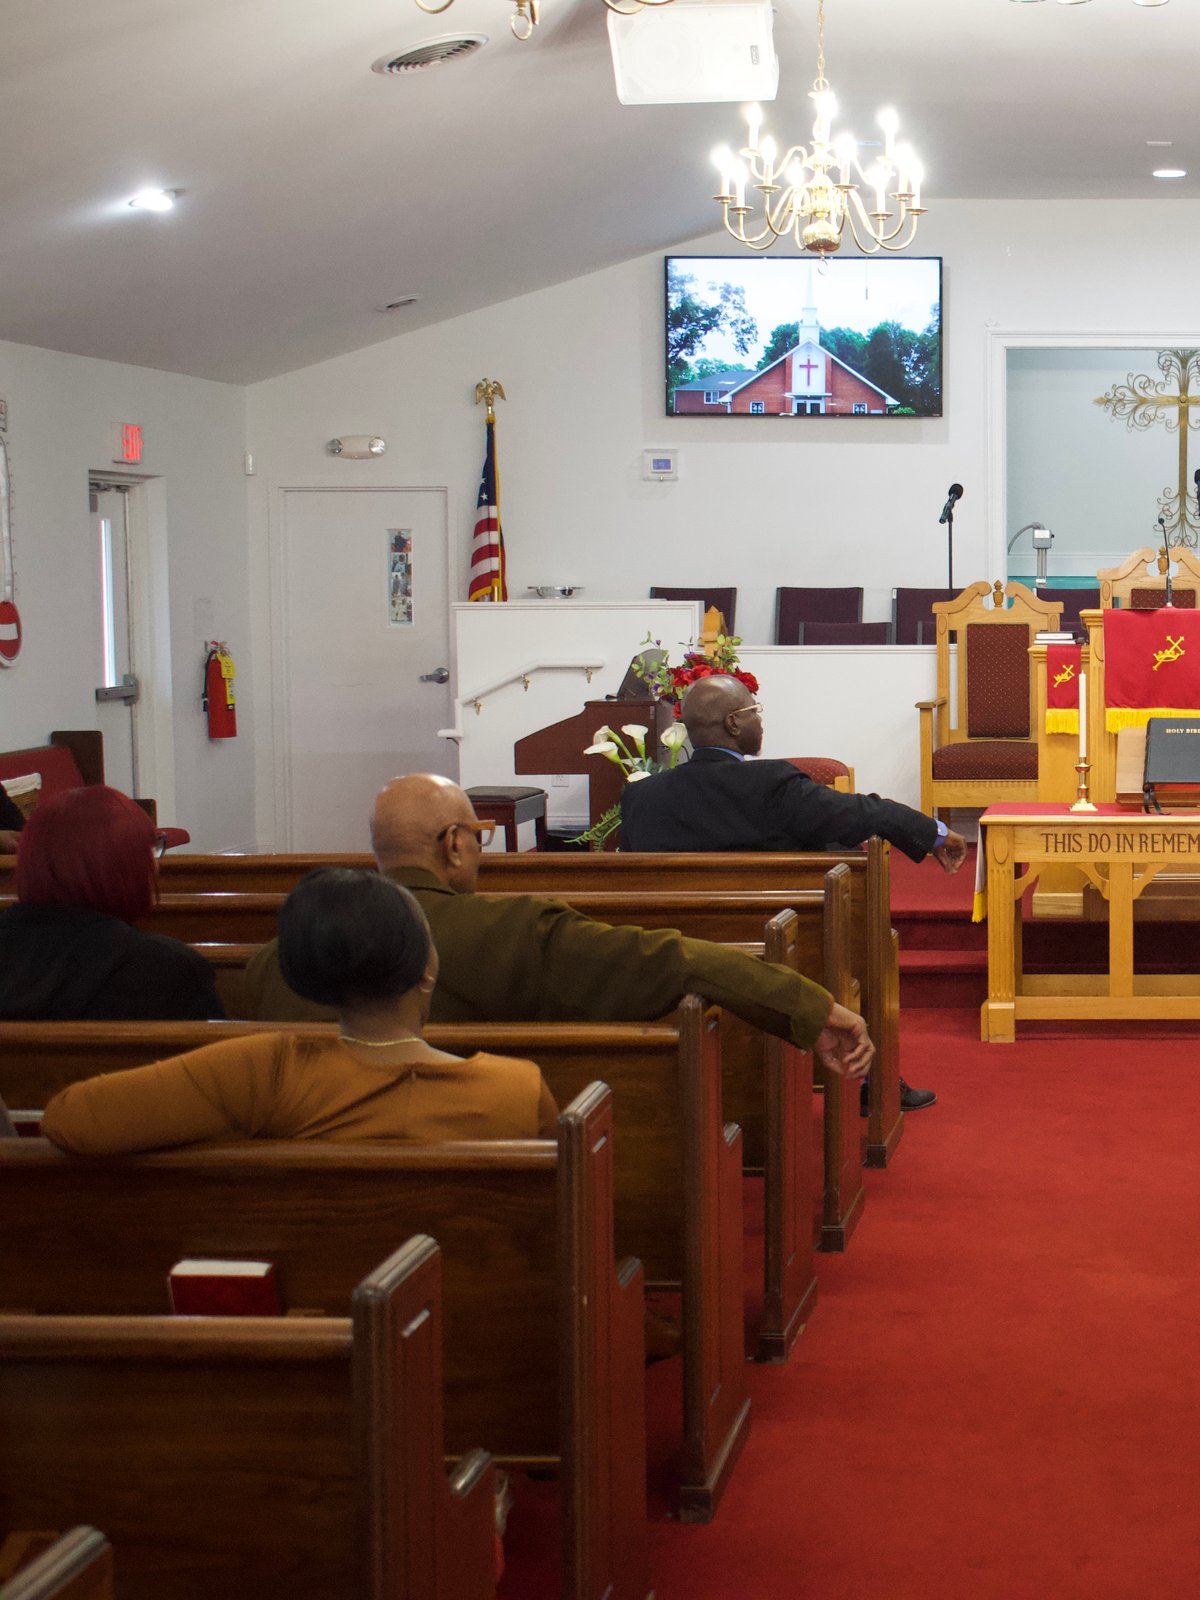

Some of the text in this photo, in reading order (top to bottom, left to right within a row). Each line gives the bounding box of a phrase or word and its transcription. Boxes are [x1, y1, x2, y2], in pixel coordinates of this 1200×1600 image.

[1040, 832, 1083, 853] THIS
[1088, 832, 1112, 853] DO
[1115, 832, 1135, 853] IN
